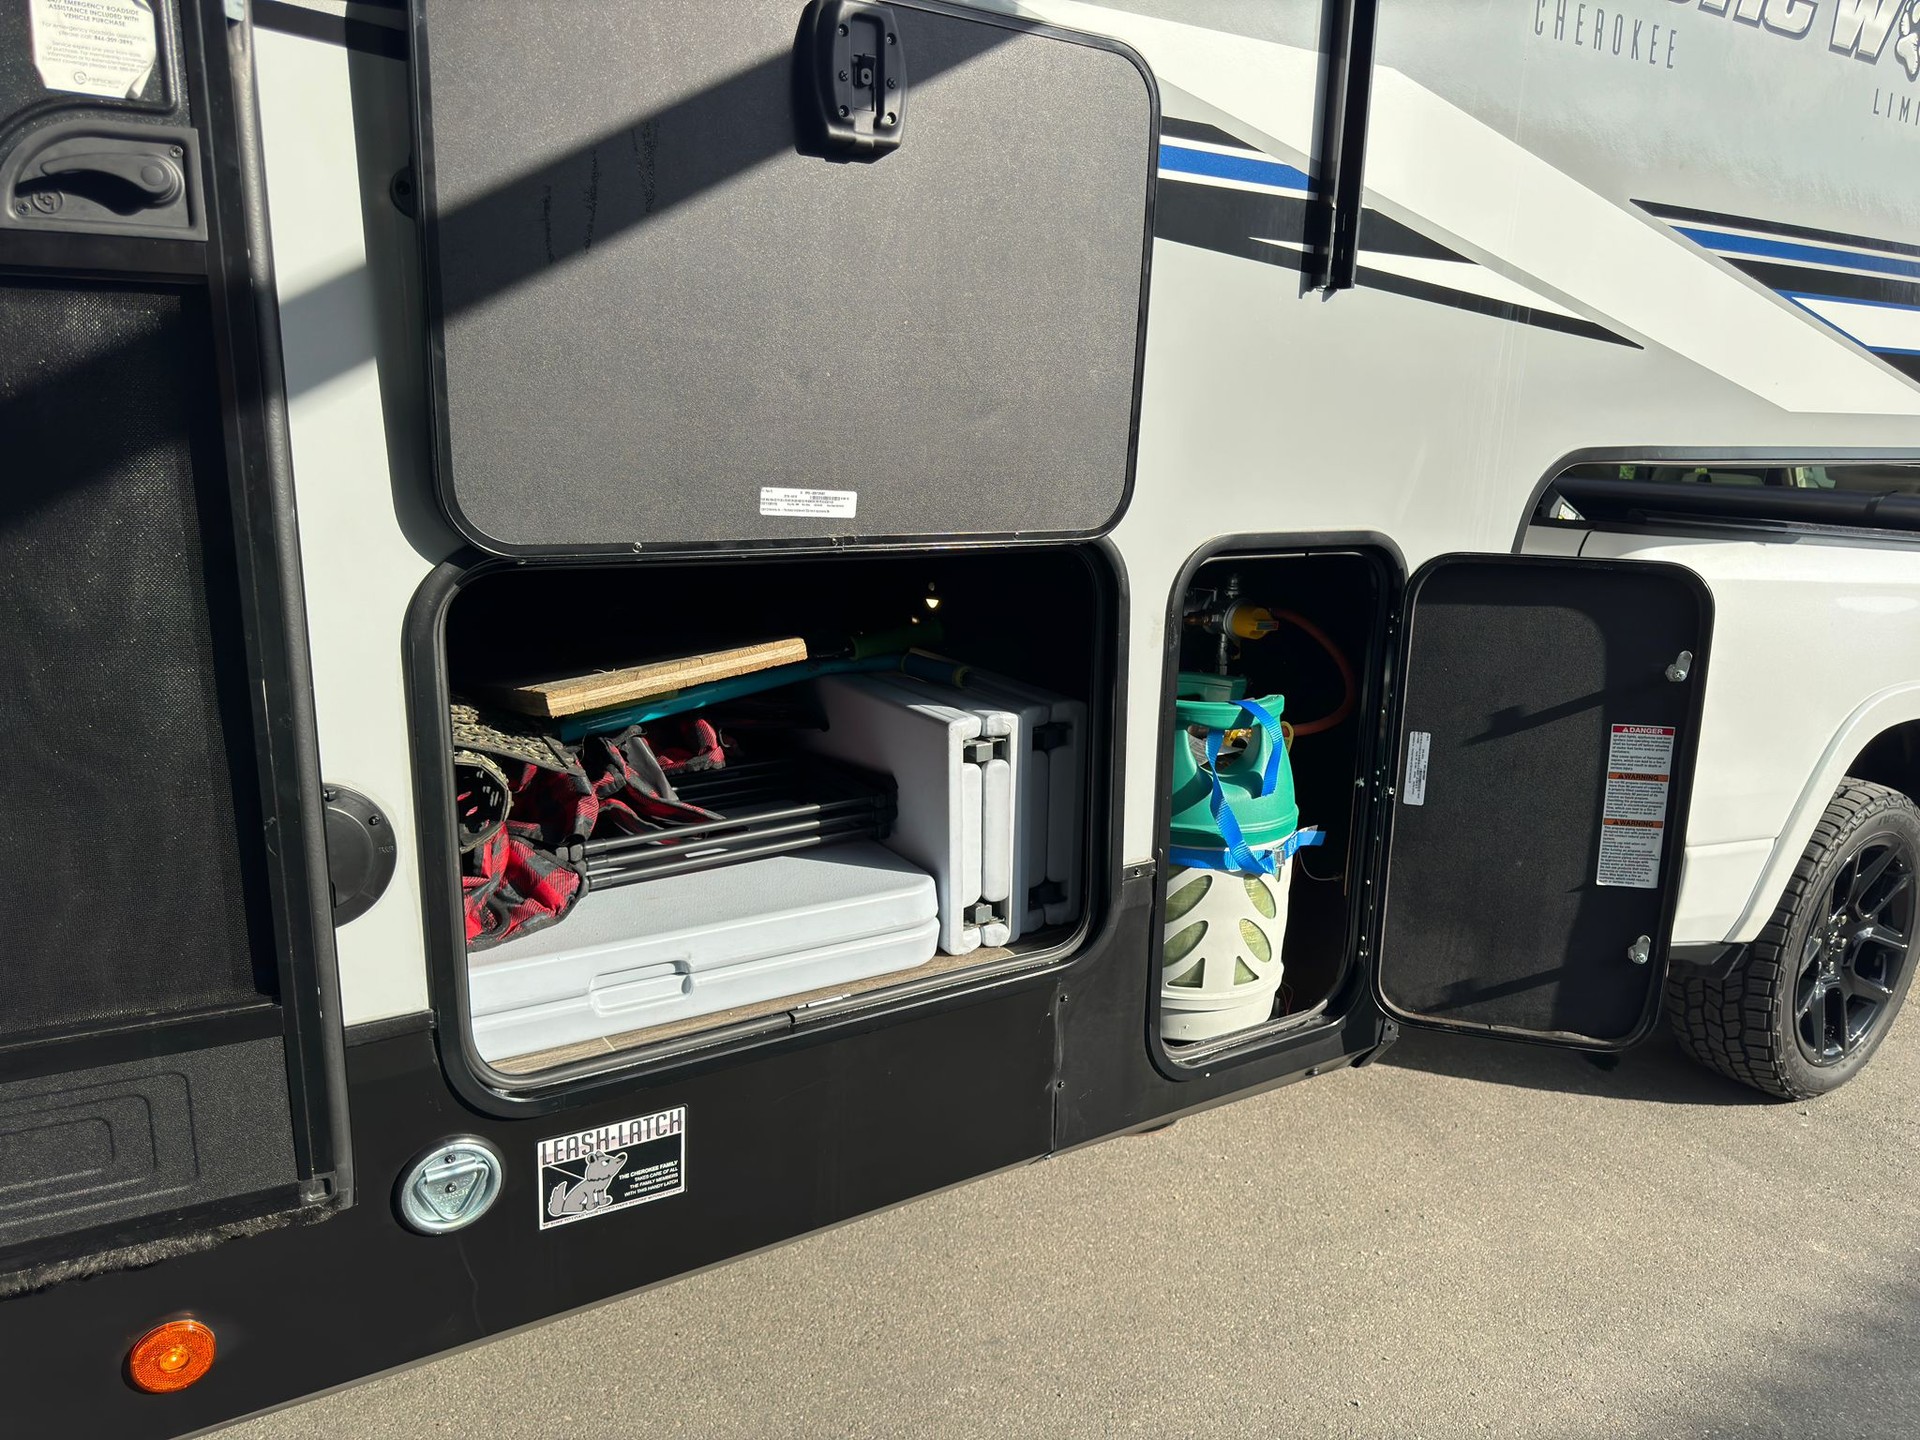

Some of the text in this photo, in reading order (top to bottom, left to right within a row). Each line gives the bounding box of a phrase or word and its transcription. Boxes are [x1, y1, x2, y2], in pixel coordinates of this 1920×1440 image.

[48, 4, 88, 14] ASSISTANCE
[90, 10, 122, 20] INCLUDED
[64, 0, 104, 11] EMERGENCY
[106, 6, 139, 15] ROADSIDE
[63, 12, 126, 27] VEHICLE PURCHASE
[1535, 0, 1677, 69] CHEROKEE
[1630, 727, 1663, 735] DANGER
[1624, 773, 1659, 781] WARNING
[1620, 819, 1654, 827] WARNING
[630, 1165, 659, 1177] CHEROKEE
[660, 1160, 678, 1169] FAMILY
[634, 1174, 649, 1182] TAKES
[640, 1179, 655, 1187] FAMILY
[656, 1173, 678, 1182] MEMBERS
[648, 1183, 663, 1191] HANDY
[664, 1179, 678, 1187] LATCH
